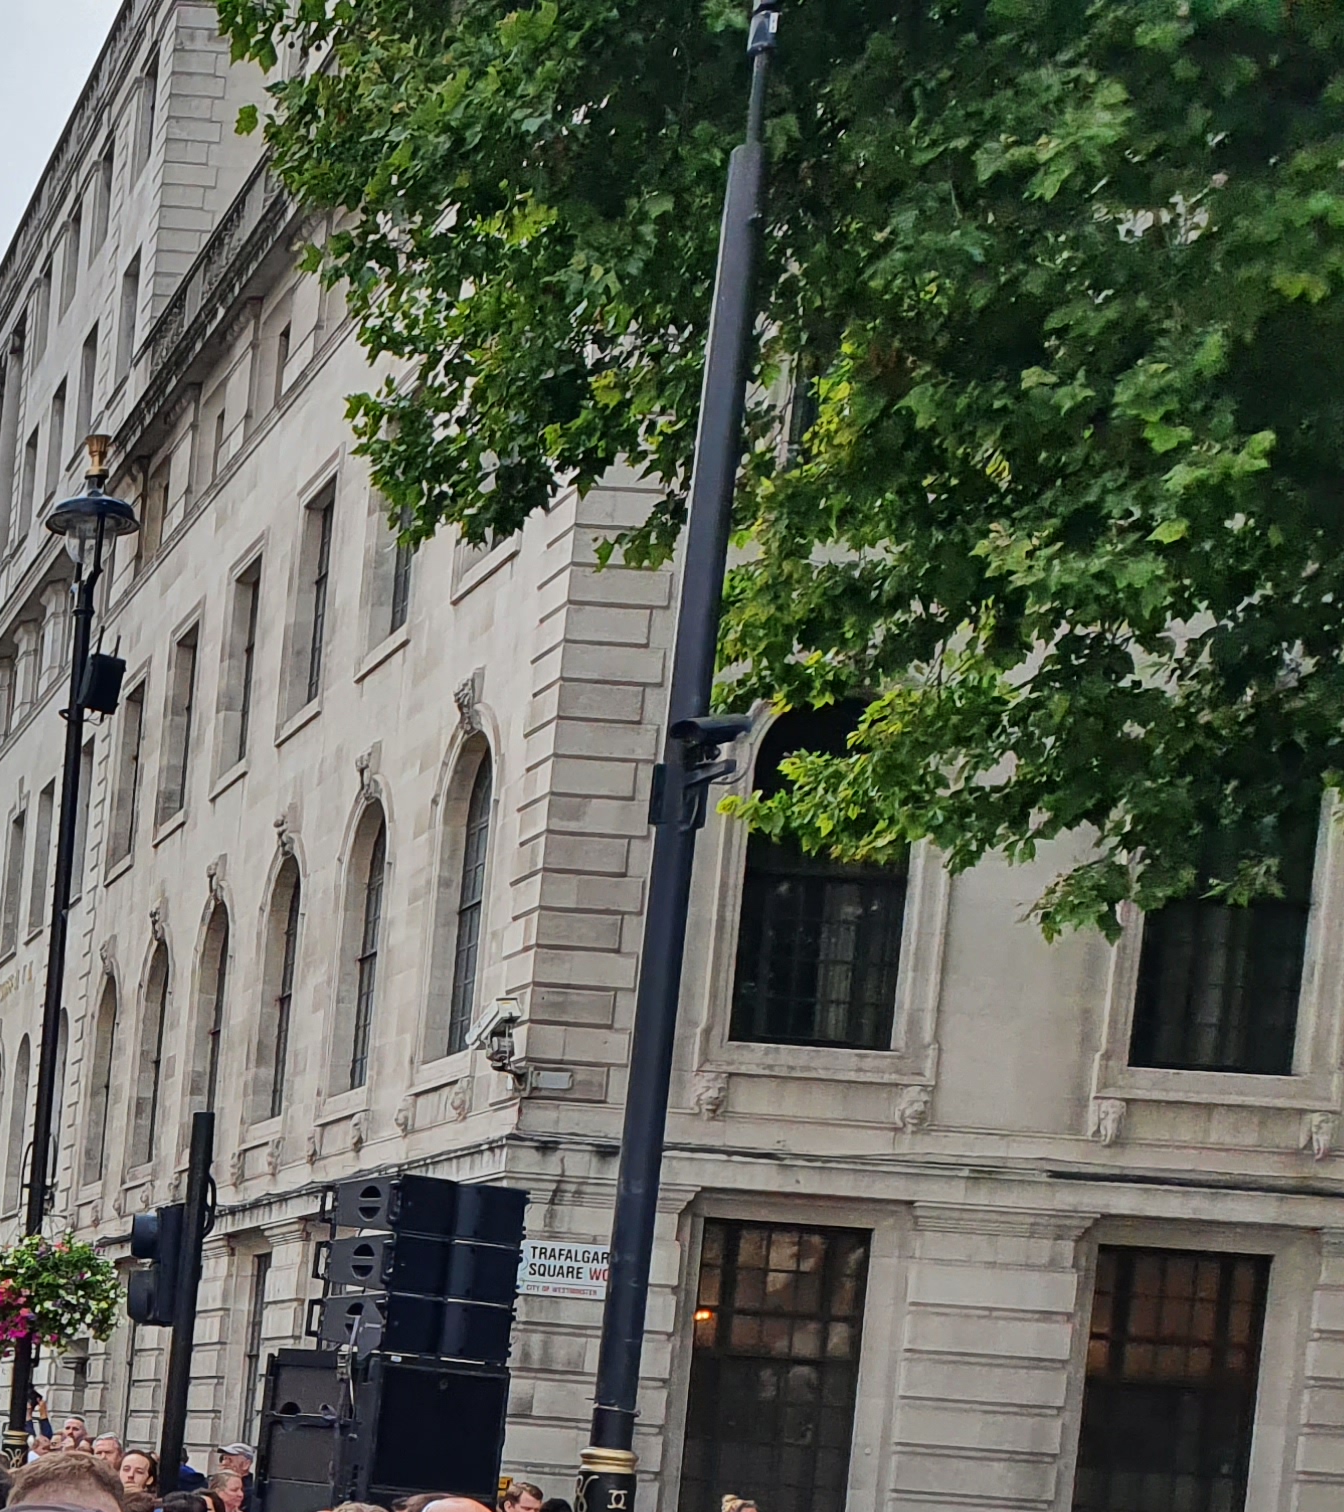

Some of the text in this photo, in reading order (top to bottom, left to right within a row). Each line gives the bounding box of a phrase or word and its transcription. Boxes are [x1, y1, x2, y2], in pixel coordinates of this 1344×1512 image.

[530, 1245, 611, 1265] TRAFALGAR
[528, 1262, 584, 1280] SQUARE
[526, 1284, 540, 1292] CITY
[552, 1287, 598, 1296] WESTMINSTER
